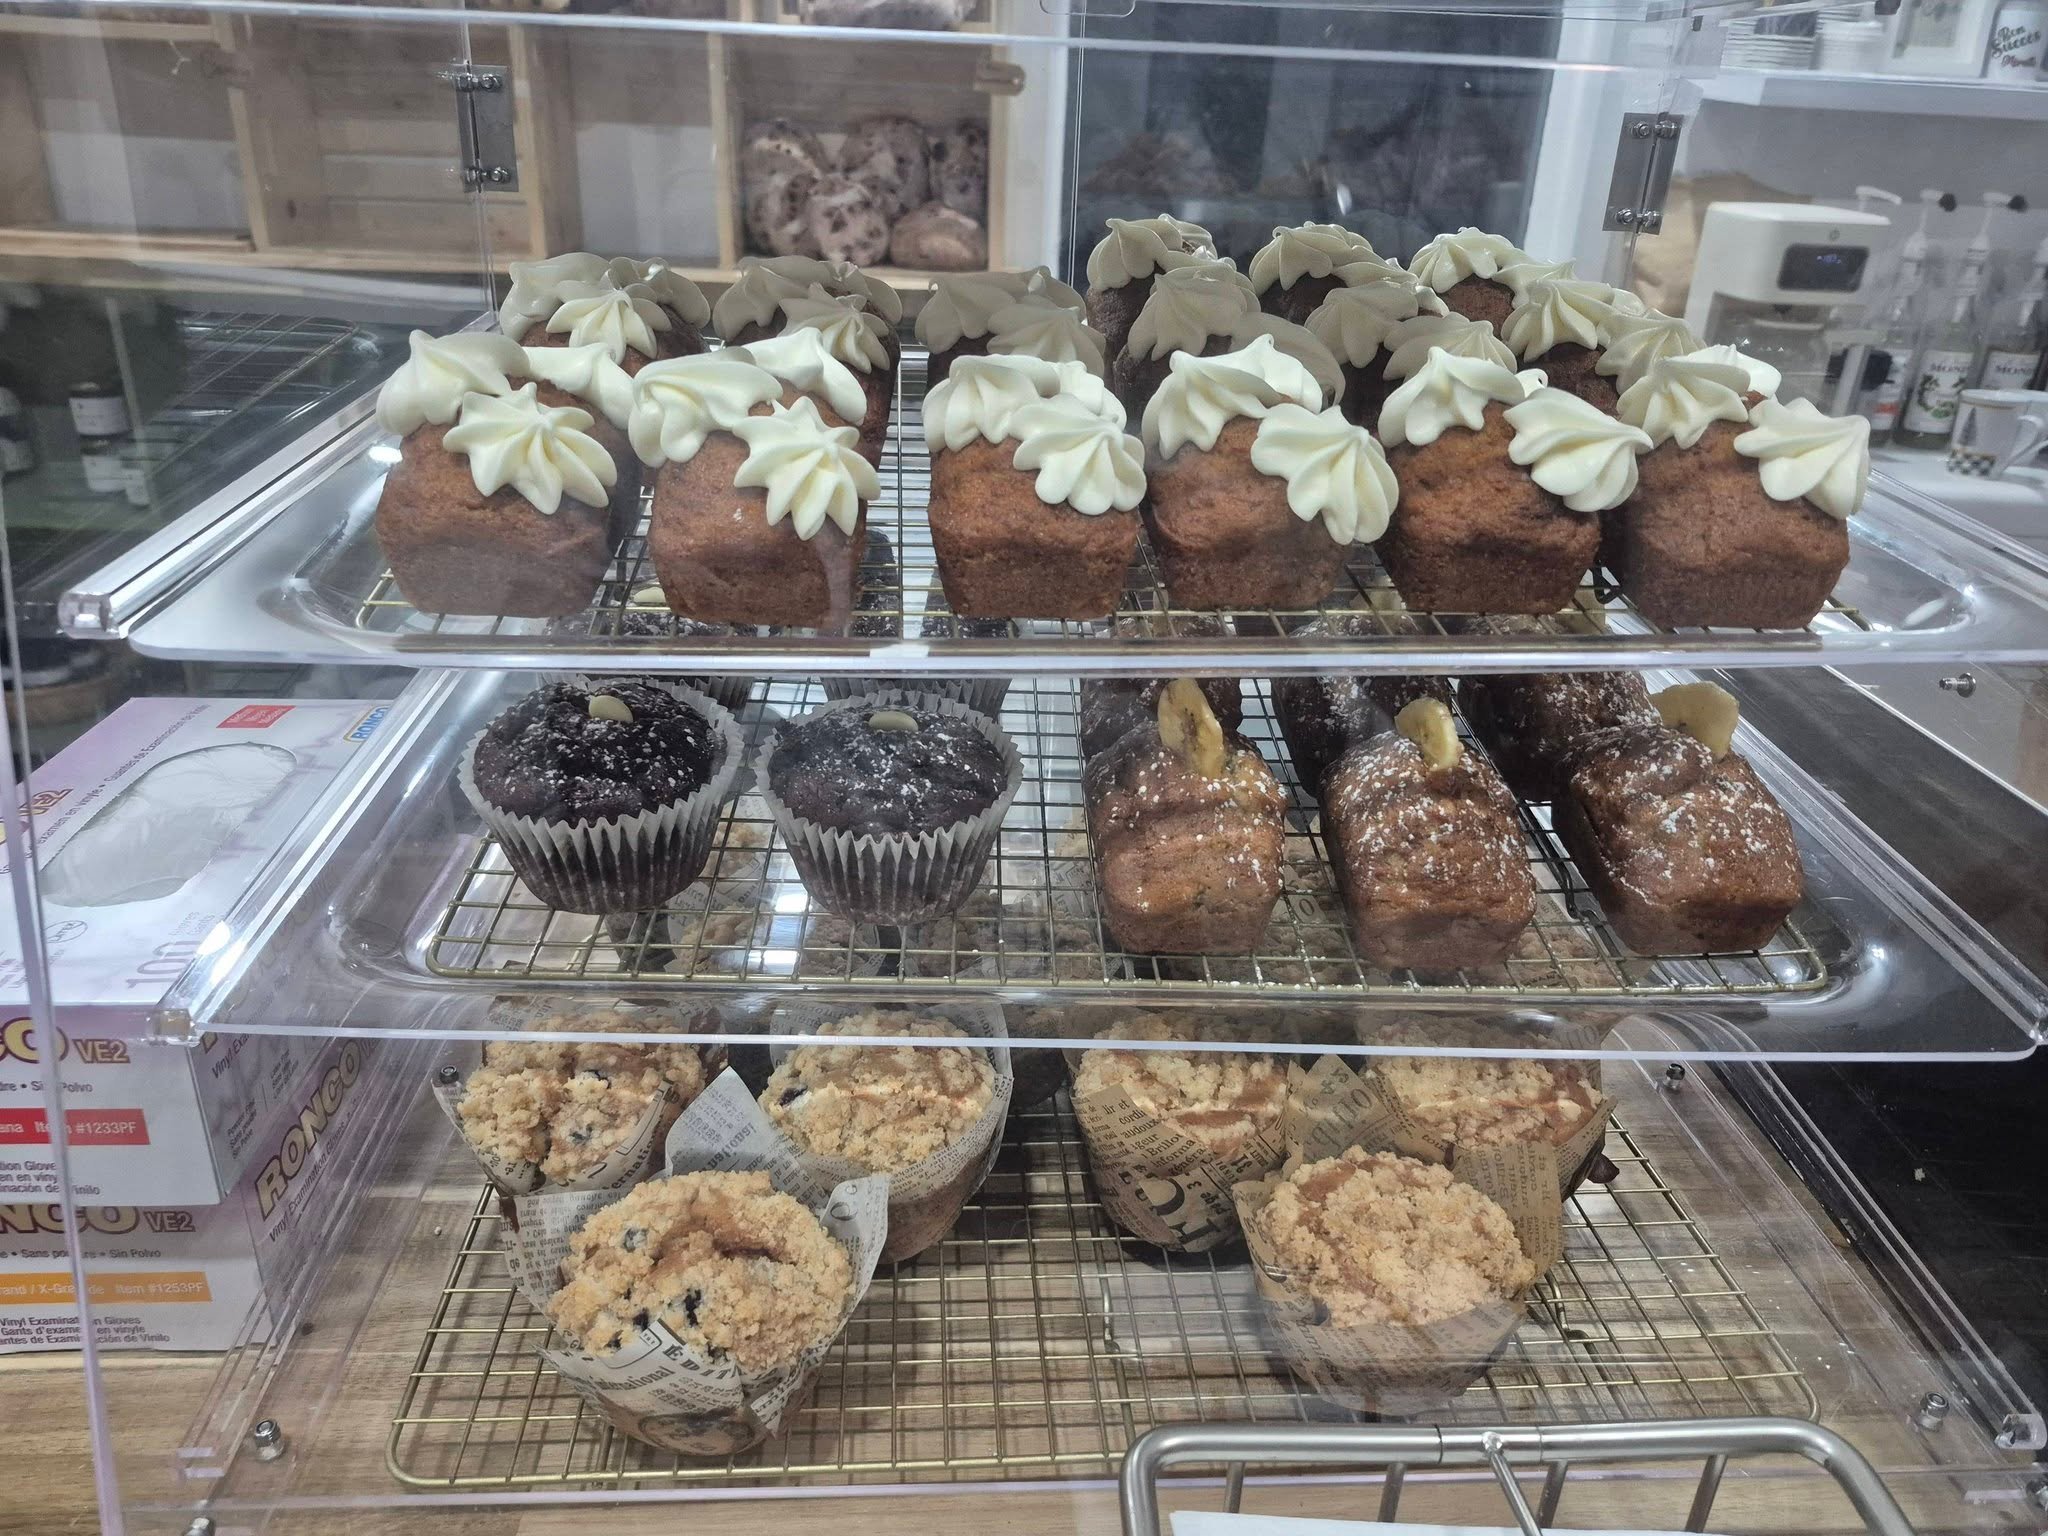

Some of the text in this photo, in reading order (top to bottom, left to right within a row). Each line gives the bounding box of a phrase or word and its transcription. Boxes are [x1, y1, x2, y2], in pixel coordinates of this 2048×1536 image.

[73, 1039, 130, 1064] VE2
[212, 1048, 233, 1079] Vinyl
[76, 1121, 136, 1135] #1233PF
[254, 1039, 361, 1222] RONCO
[24, 1160, 57, 1171] Glove
[17, 1173, 31, 1182] en
[144, 1211, 196, 1233] VE2
[268, 1211, 290, 1243] Vinyl
[22, 1249, 49, 1259] Sans
[110, 1249, 127, 1258] Sin
[149, 1282, 204, 1295] #1253PF
[1, 1317, 26, 1328] Vinyl
[104, 1316, 142, 1325] Gloves
[2, 1328, 33, 1336] Gants
[30, 1336, 43, 1345] de
[141, 1334, 171, 1344] Vinilo
